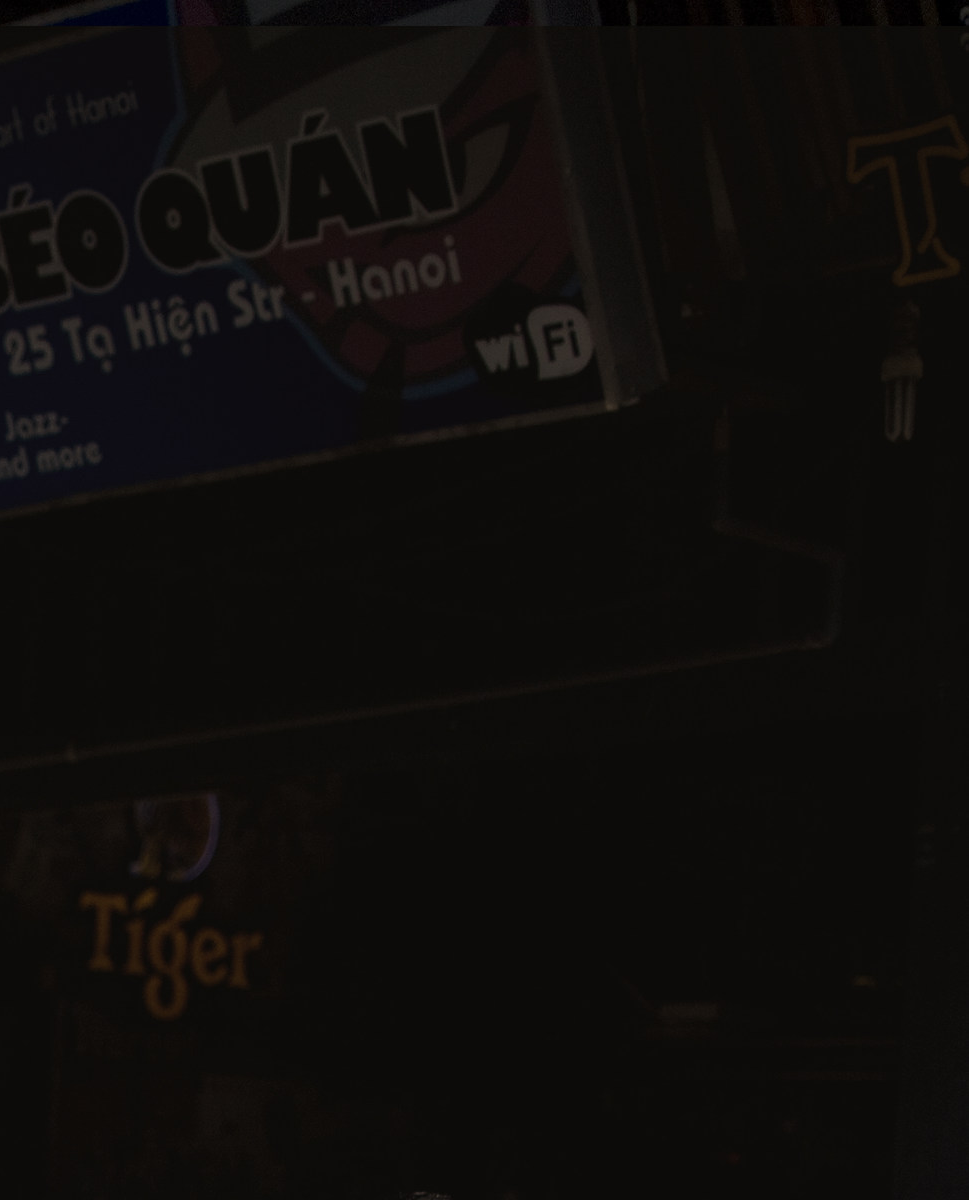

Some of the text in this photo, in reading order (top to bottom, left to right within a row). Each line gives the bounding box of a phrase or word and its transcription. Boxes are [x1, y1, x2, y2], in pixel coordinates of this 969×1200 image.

[33, 94, 59, 137] of
[65, 80, 140, 128] Hanoi
[133, 104, 459, 277] QUÁN
[846, 112, 969, 288] T
[3, 322, 56, 377] 25
[60, 315, 117, 376] Tạ
[123, 295, 220, 359] Hiện
[226, 277, 285, 330] Str
[326, 234, 463, 309] Hanoi
[35, 440, 103, 474] more
[78, 885, 266, 1022] Tiger
